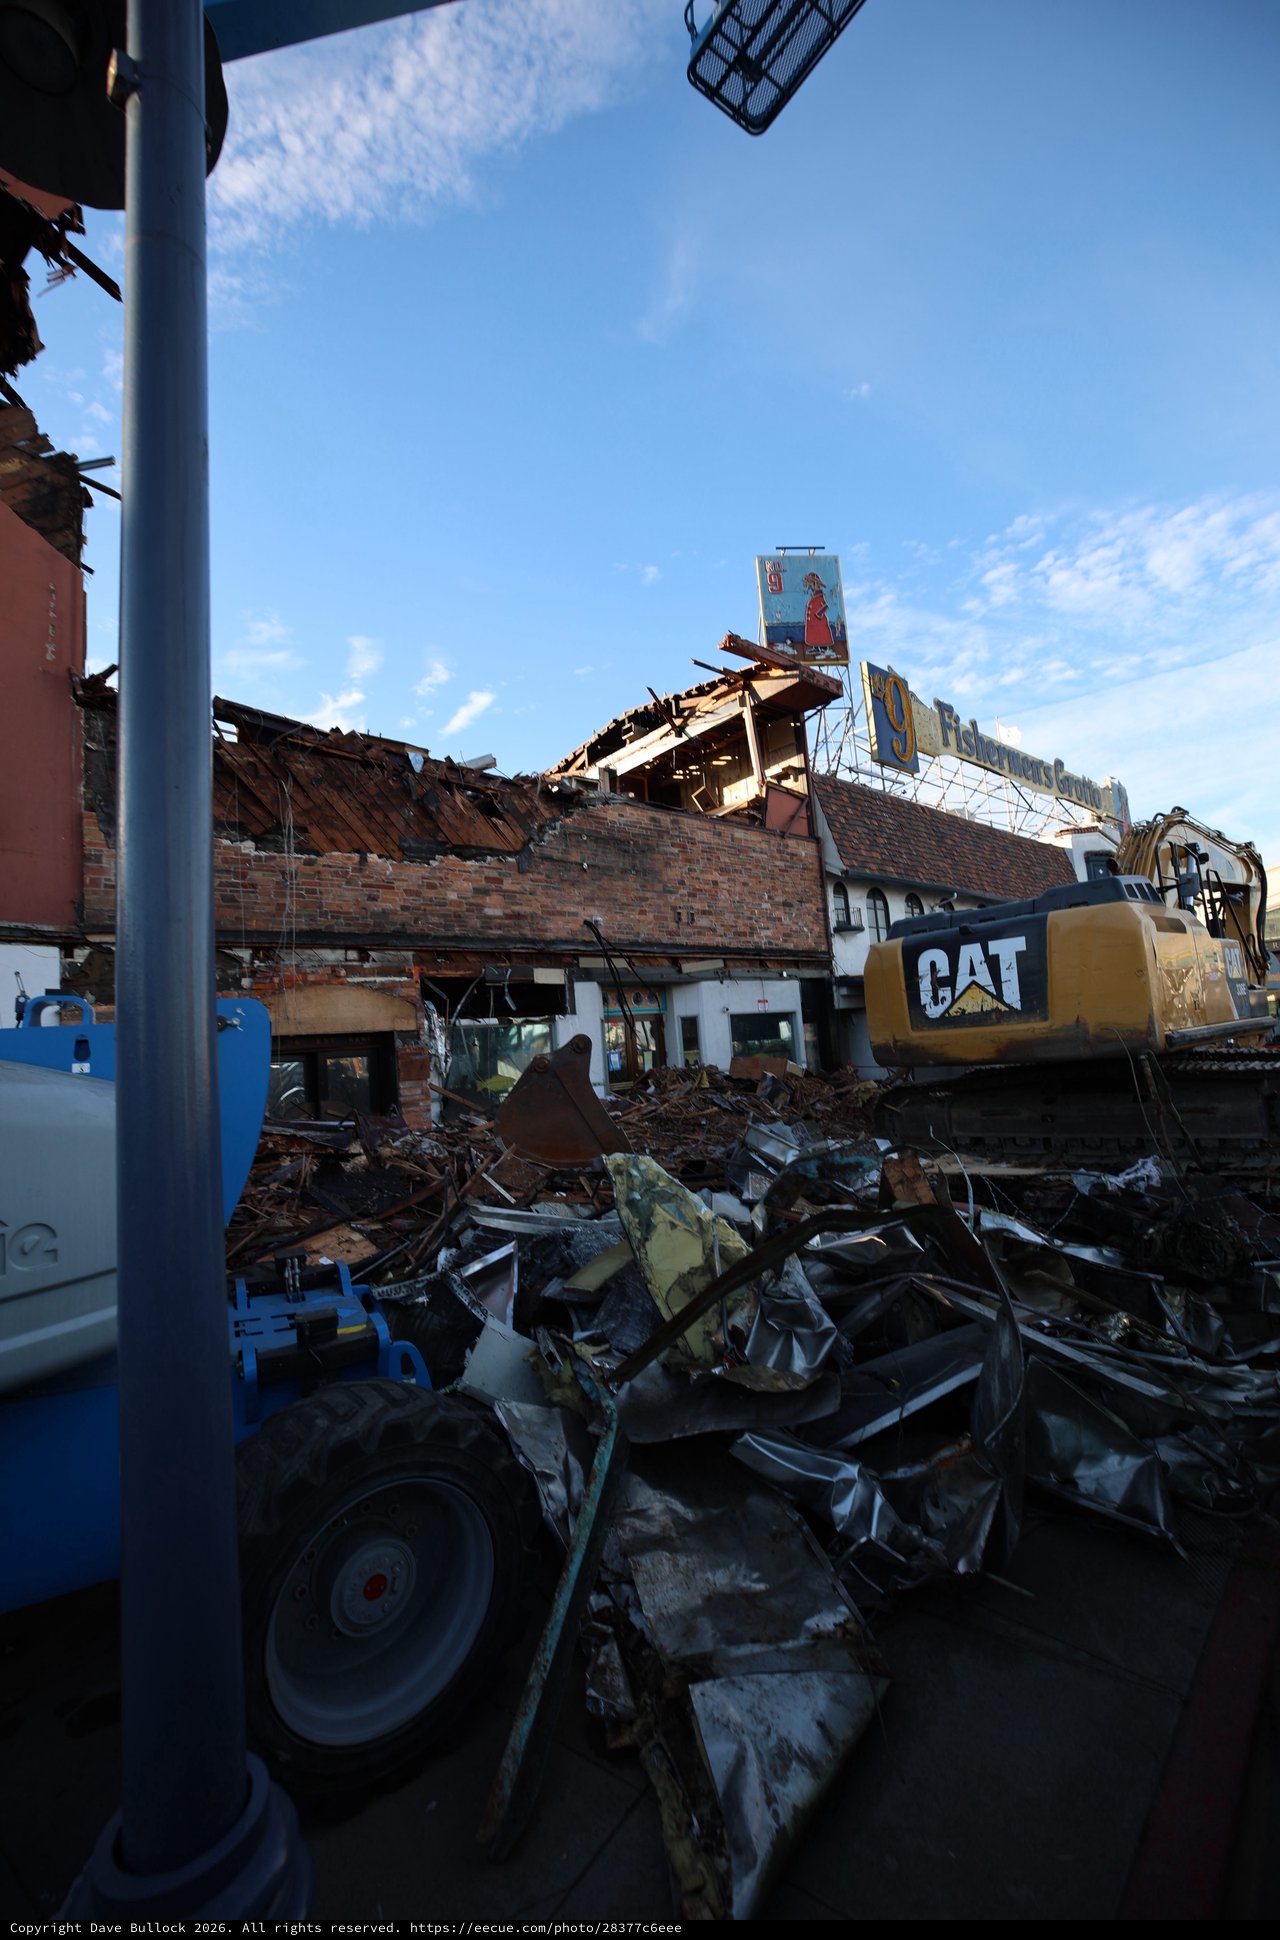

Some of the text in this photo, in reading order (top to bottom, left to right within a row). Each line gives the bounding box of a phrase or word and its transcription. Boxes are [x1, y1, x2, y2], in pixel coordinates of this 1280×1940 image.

[766, 572, 784, 595] 9
[885, 674, 914, 763] 9
[933, 697, 1103, 810] Fishermen's Grotto
[916, 935, 1027, 1020] CAT
[1224, 947, 1244, 979] CAT
